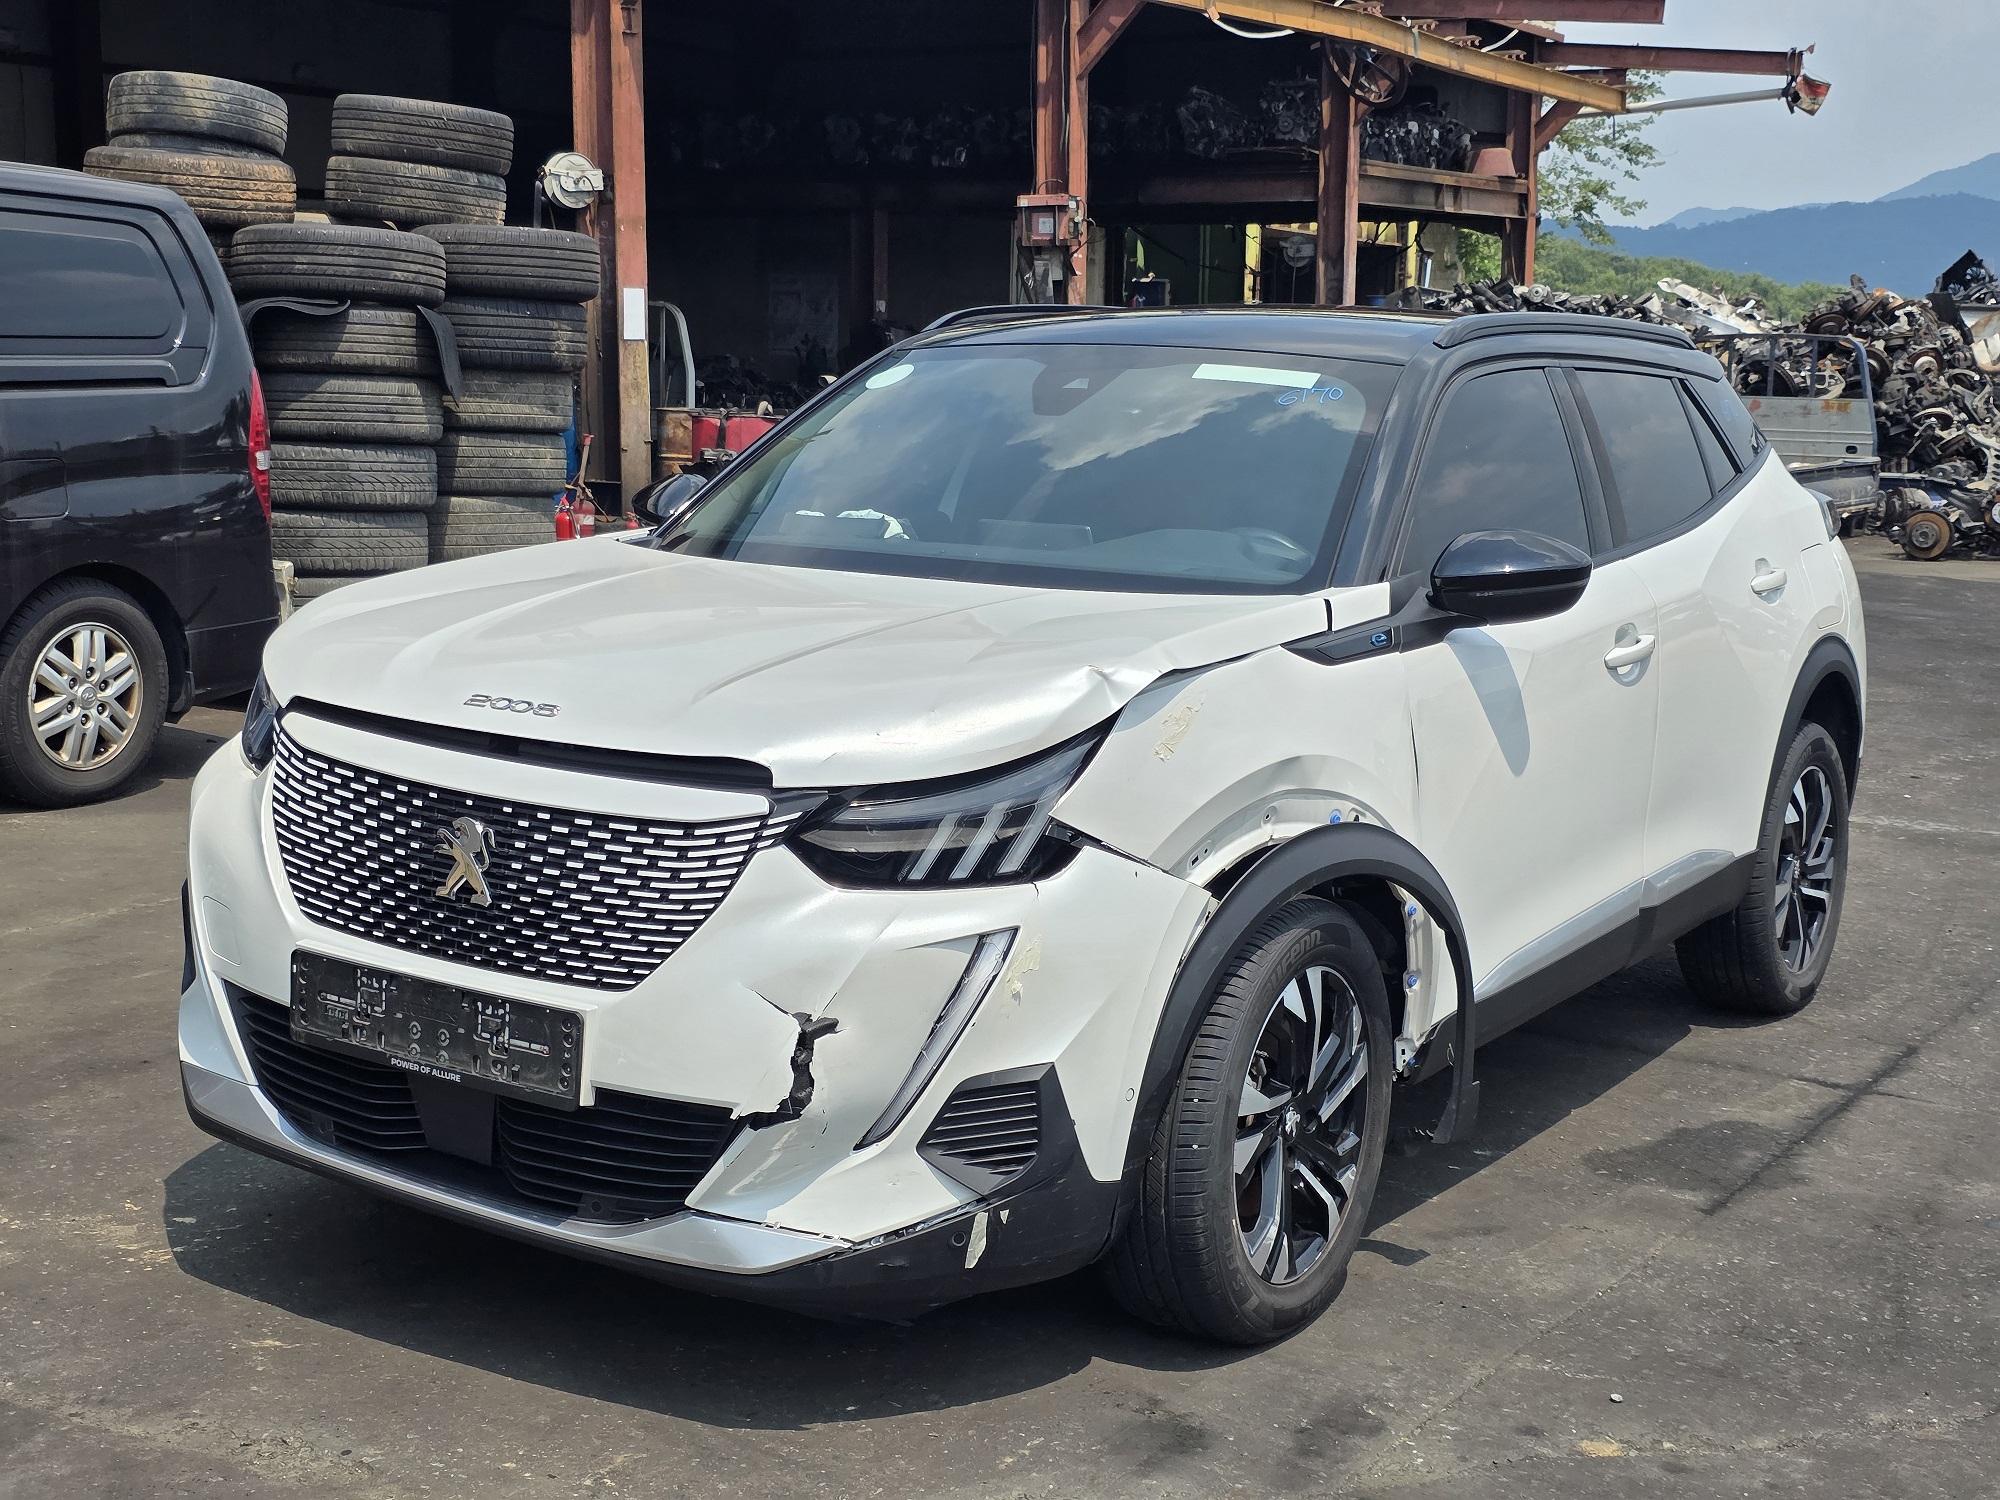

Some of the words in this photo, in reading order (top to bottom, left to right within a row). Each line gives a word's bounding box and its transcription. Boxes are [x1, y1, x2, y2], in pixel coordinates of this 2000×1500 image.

[1277, 387, 1343, 406] 6170
[1371, 633, 1387, 647] e
[463, 694, 562, 718] 2008
[1260, 929, 1323, 1004] aufenn
[391, 1057, 419, 1072] POWER
[420, 1065, 431, 1074] OF
[431, 1068, 461, 1083] ALLURE
